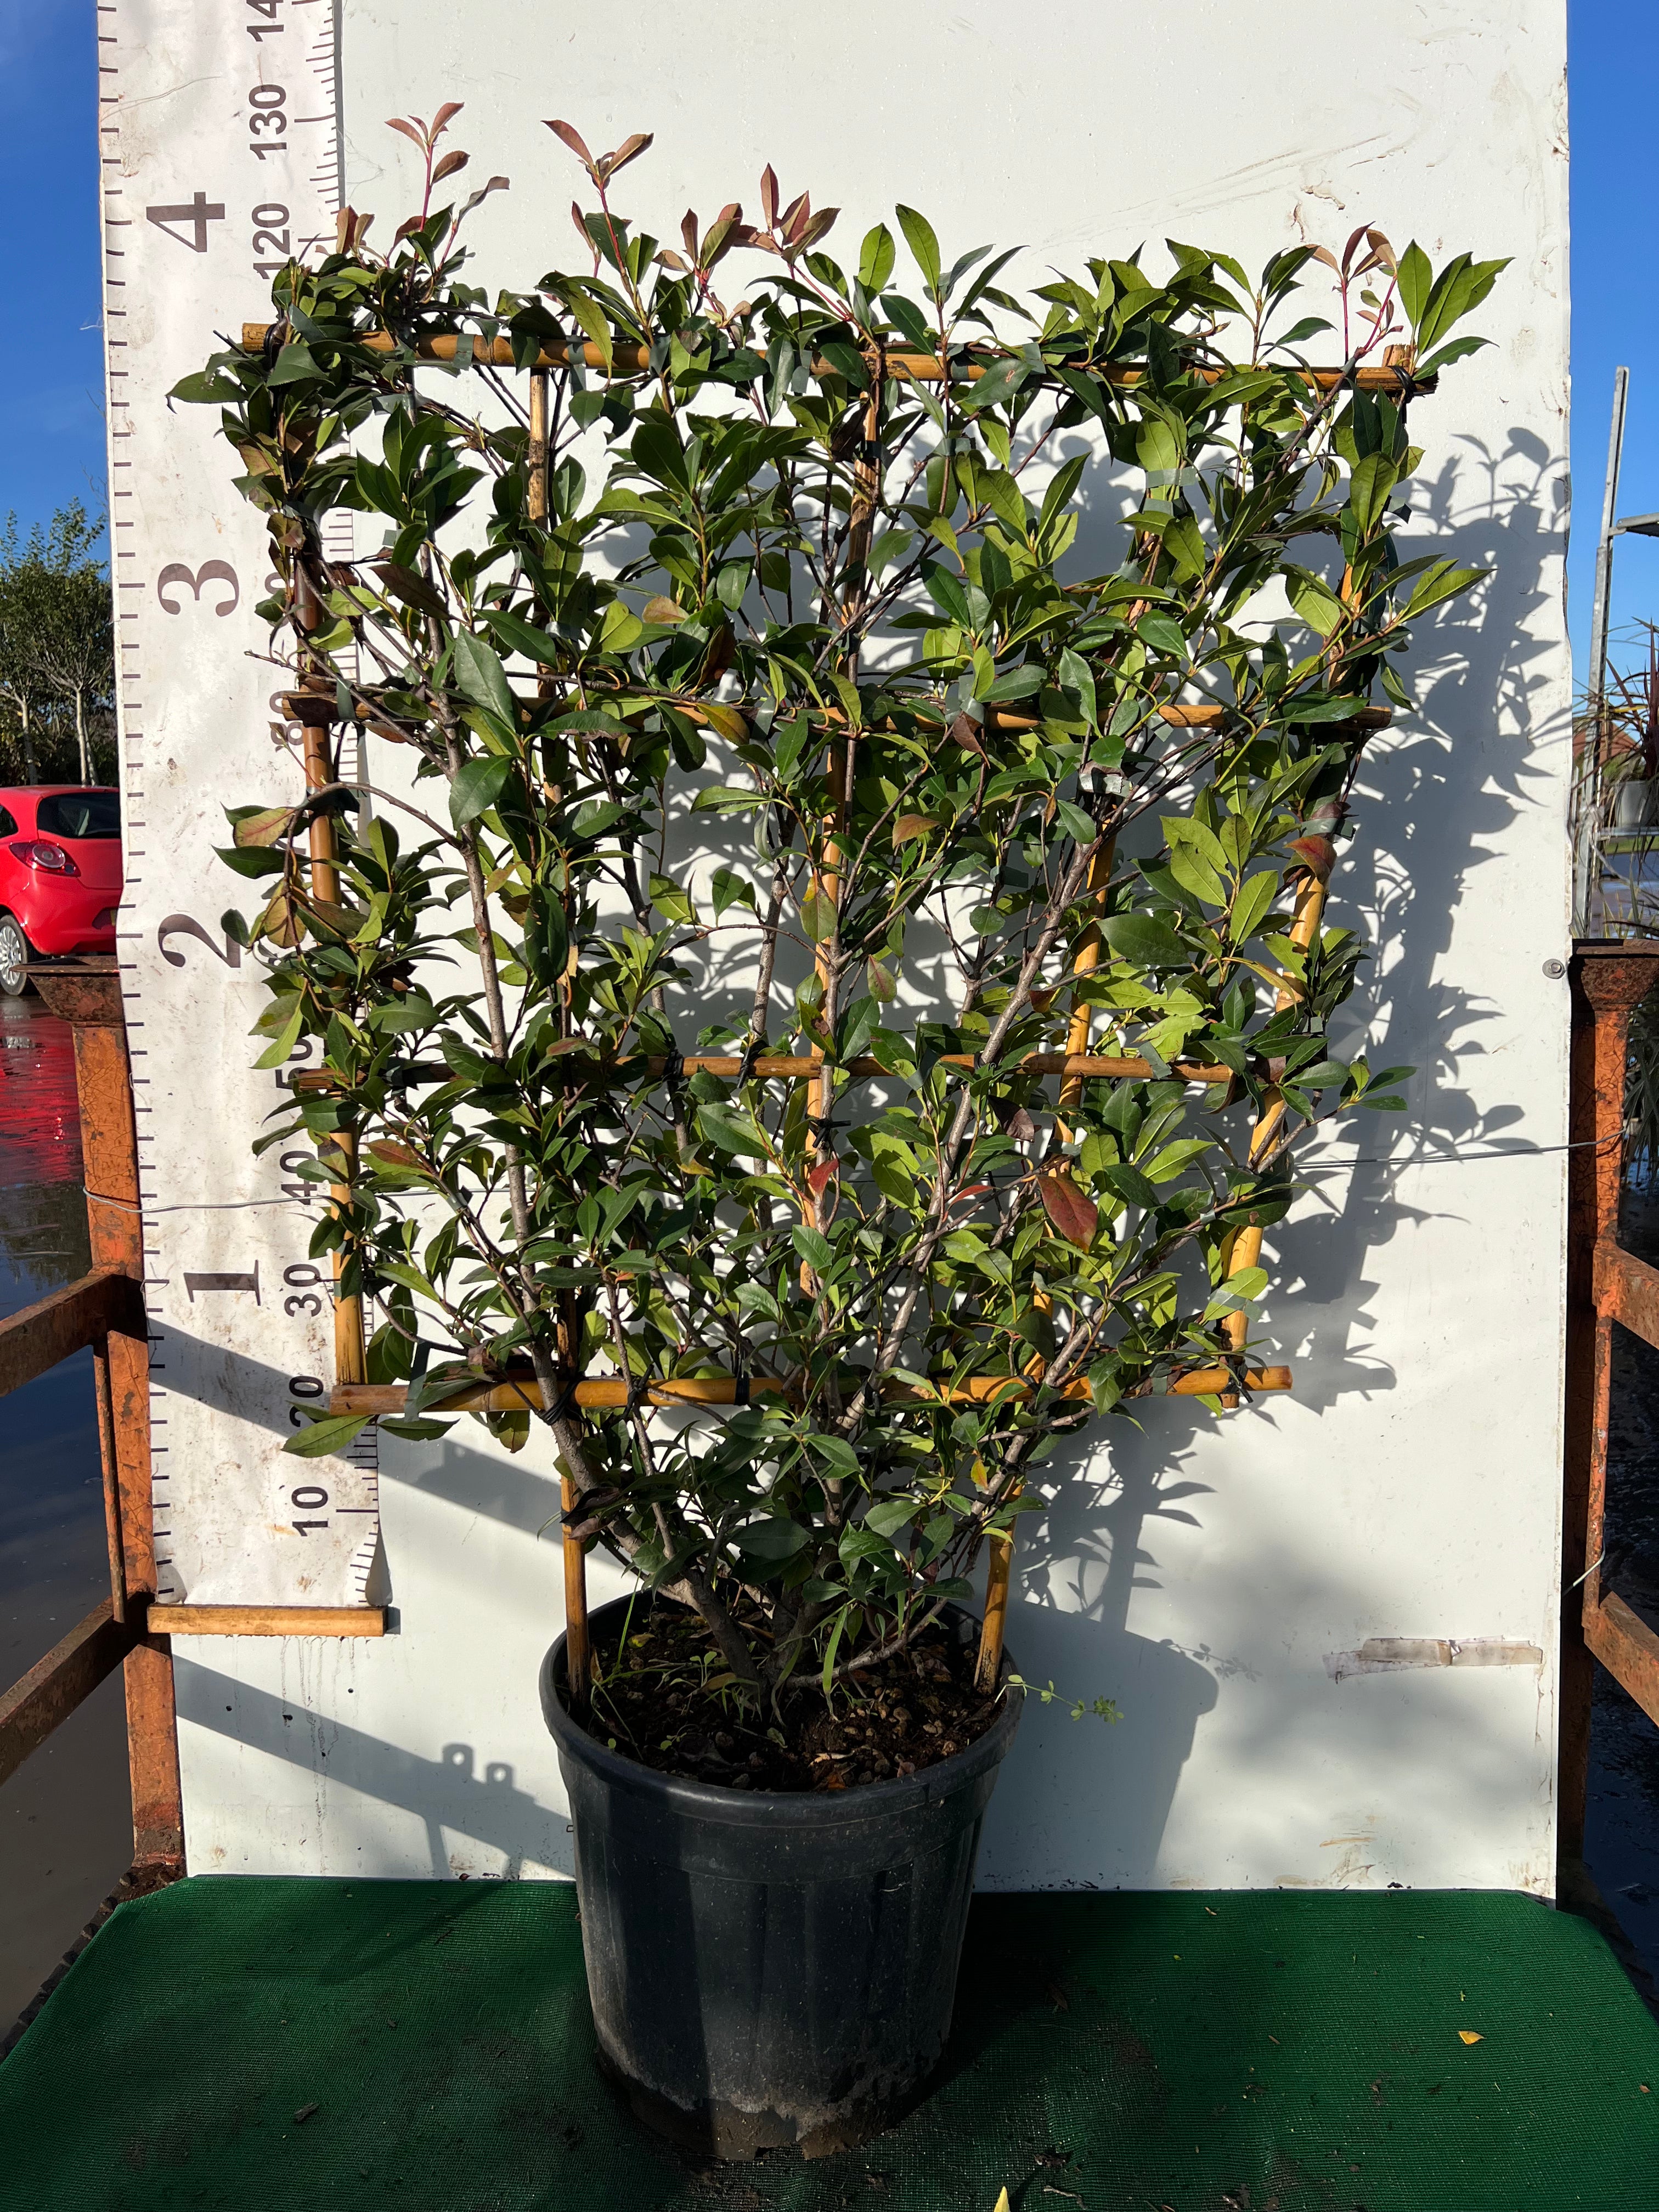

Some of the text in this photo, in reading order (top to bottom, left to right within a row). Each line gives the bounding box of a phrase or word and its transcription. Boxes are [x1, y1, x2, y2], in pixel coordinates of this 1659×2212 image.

[249, 84, 287, 160] 130
[146, 191, 225, 253] 4
[251, 203, 290, 280] 120
[157, 560, 240, 618] 3
[158, 914, 241, 968] 2
[280, 1150, 318, 1205] 40
[183, 1260, 261, 1306] 1
[284, 1263, 322, 1317] 30
[291, 1486, 329, 1537] 10
